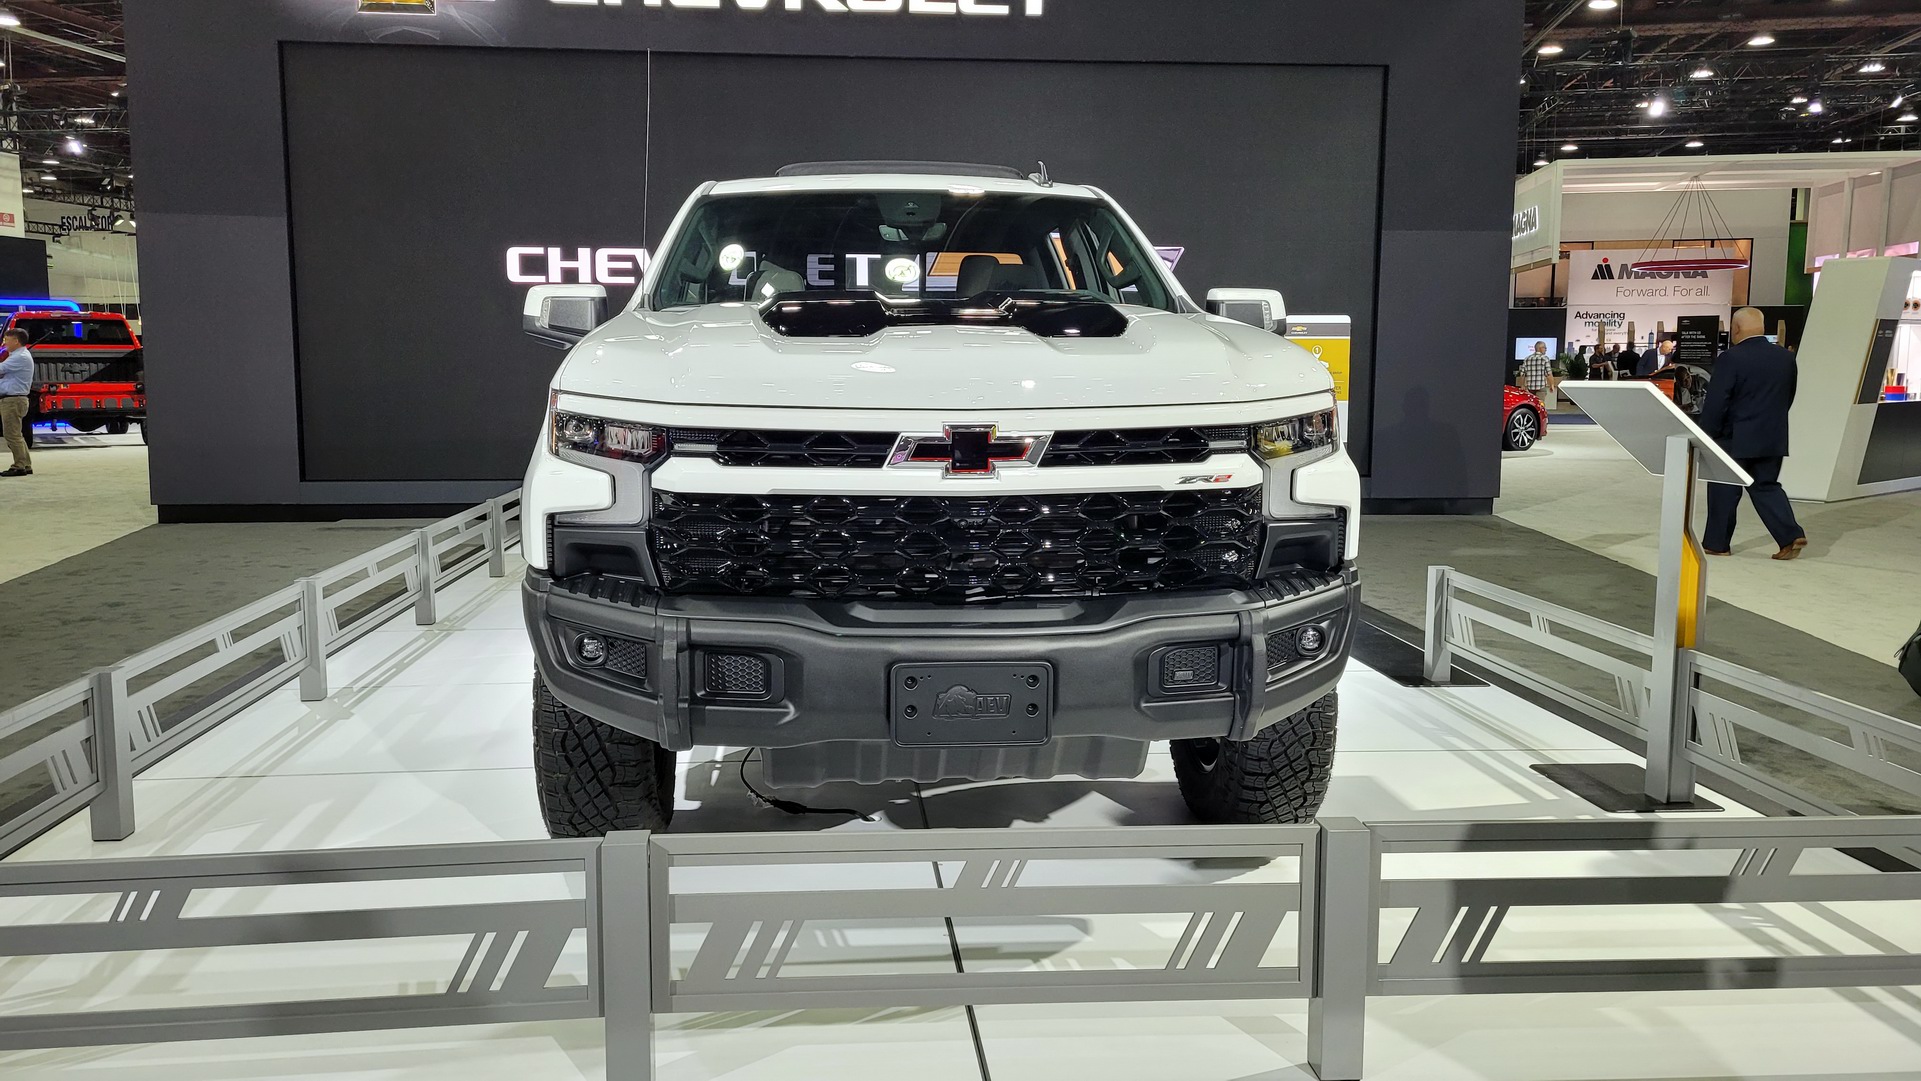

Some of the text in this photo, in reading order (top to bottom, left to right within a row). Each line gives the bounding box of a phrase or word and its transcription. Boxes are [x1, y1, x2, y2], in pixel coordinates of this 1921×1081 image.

[60, 215, 114, 232] ESCALOR
[1616, 285, 1710, 298] Forward. For all.
[1574, 310, 1626, 320] Advancing
[1175, 474, 1233, 485] ZR2
[976, 696, 1008, 713] AEV
